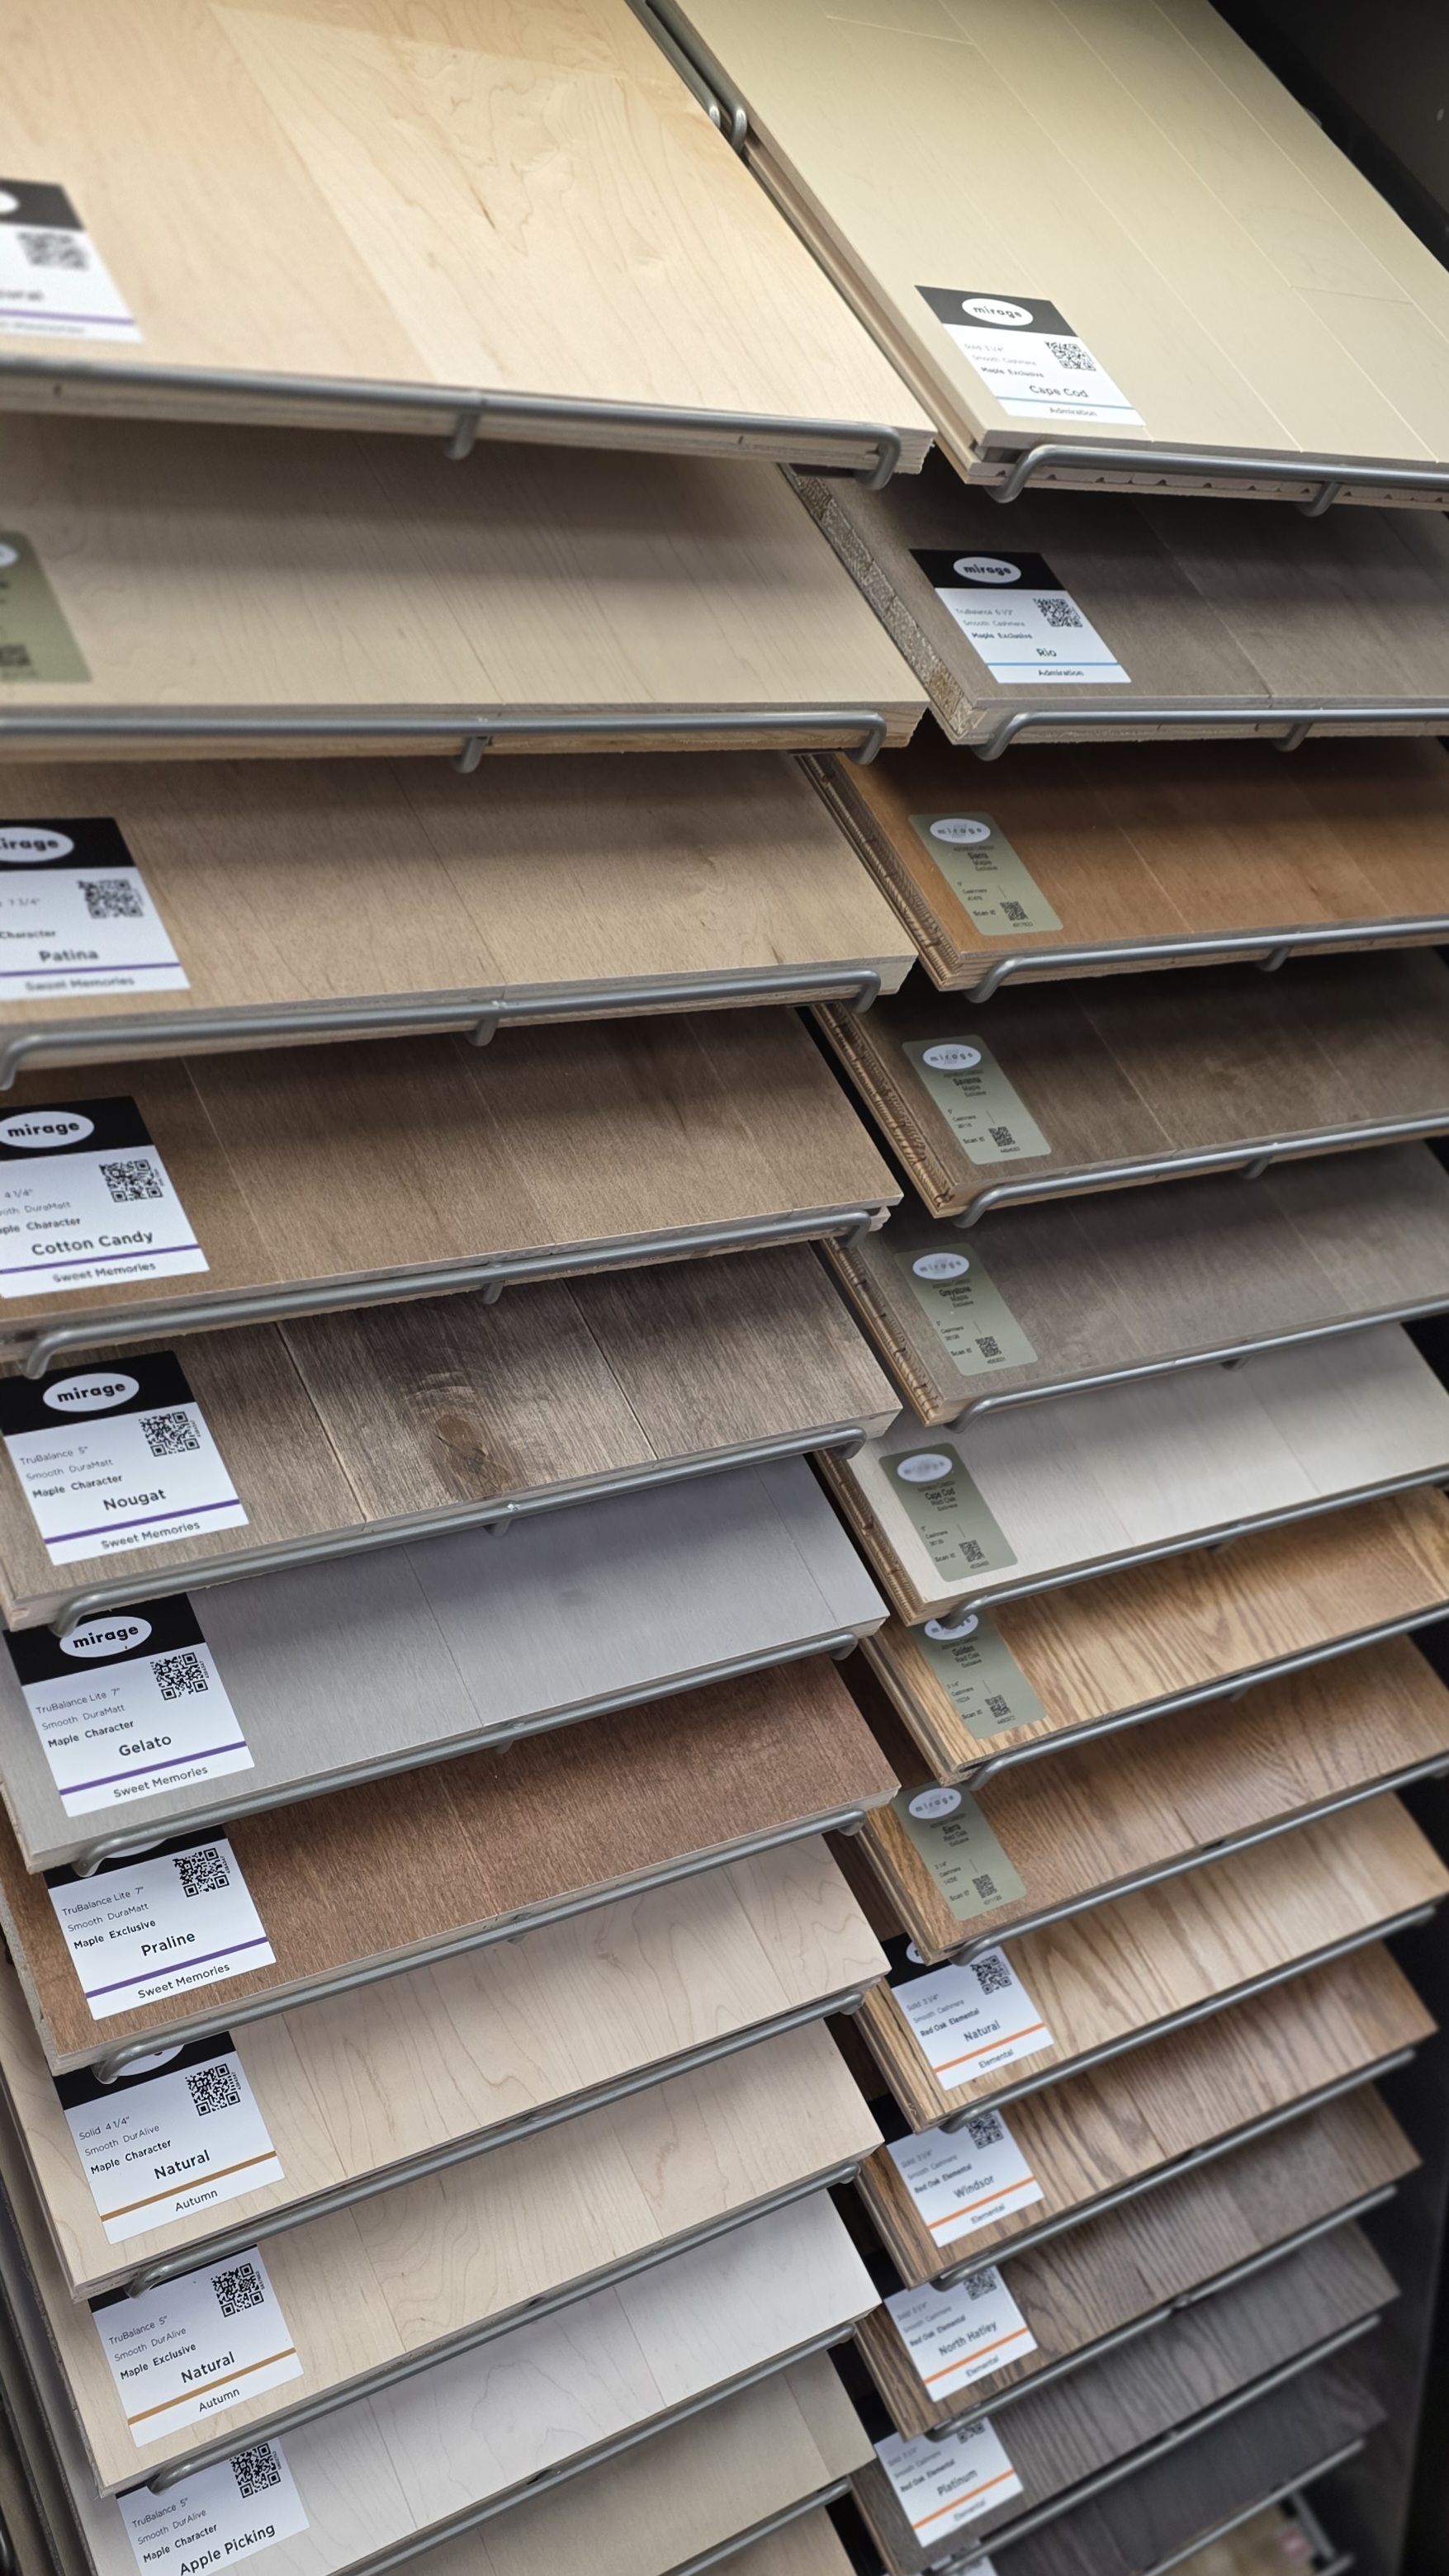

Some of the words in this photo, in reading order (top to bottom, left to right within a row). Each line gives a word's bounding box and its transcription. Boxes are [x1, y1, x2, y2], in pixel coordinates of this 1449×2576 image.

[973, 306, 1022, 318] mirage
[1007, 369, 1044, 378] Exclusive
[1030, 385, 1060, 398] Cape
[1063, 388, 1089, 398] Cod
[964, 565, 1011, 575] mirage
[1036, 648, 1057, 657] Rio
[0, 839, 59, 851] irage
[39, 950, 98, 962] Patina
[25, 981, 67, 990] Sweet
[71, 977, 135, 988] Memories
[7, 1123, 80, 1137] mirage
[26, 1217, 80, 1231] Character
[31, 1239, 93, 1255] Cotton
[98, 1231, 154, 1247] Candy
[53, 1270, 92, 1283] Sweet
[96, 1263, 155, 1277] Memories
[57, 1382, 125, 1402] mirage
[20, 1449, 73, 1466] TruBalance
[78, 1446, 88, 1454] 5"
[26, 1468, 64, 1482] Smooth
[69, 1458, 114, 1473] DuraMatt
[32, 1485, 65, 1499] Maple
[71, 1474, 122, 1491] Character
[102, 1489, 167, 1510] Nougat
[101, 1534, 139, 1550] Sweet
[141, 1521, 200, 1539] Memories
[73, 1626, 139, 1649] mirage
[36, 1697, 88, 1714] TruBalance
[90, 1692, 107, 1702] Lite
[111, 1688, 121, 1697] 7"
[41, 1716, 78, 1731] Smooth
[83, 1704, 125, 1721] DuraMatt
[48, 1733, 79, 1748] Maple
[84, 1720, 134, 1738] Character
[119, 1736, 172, 1756] Gelato
[114, 1781, 150, 1798] Sweet
[152, 1766, 208, 1788] Memories
[61, 1895, 112, 1917] TruBalance
[114, 1891, 130, 1902] Lite
[135, 1887, 144, 1895] 7"
[68, 1916, 103, 1932] Smooth
[107, 1903, 149, 1921] DuraMatt
[73, 1935, 104, 1950] Maple
[109, 1920, 156, 1940] Exclusive
[140, 1932, 196, 1956] Praline
[138, 1982, 173, 1999] Sweet
[175, 1963, 230, 1986] Memories
[920, 2028, 934, 2037] Red
[935, 2022, 947, 2031] Oak
[949, 2009, 980, 2025] Elemental
[964, 2020, 1001, 2042] Natural
[978, 2049, 1014, 2068] Elemental
[79, 2127, 101, 2141] Solid
[113, 2116, 130, 2129] 1/4"
[84, 2140, 118, 2157] Smooth
[123, 2124, 160, 2143] DurAlive
[91, 2158, 120, 2174] Maple
[125, 2139, 172, 2161] Character
[154, 2149, 211, 2179] Natural
[928, 2179, 940, 2187] Oak
[942, 2164, 973, 2181] Elemental
[954, 2176, 994, 2198] Windsor
[175, 2190, 217, 2212] Autumn
[971, 2204, 1006, 2224] Elemental
[108, 2321, 155, 2345] TruBalance
[159, 2316, 168, 2325] 5"
[939, 2337, 966, 2356] North
[967, 2322, 997, 2341] Hatley
[114, 2343, 147, 2362] Smooth
[151, 2328, 186, 2347] DurAlive
[121, 2362, 149, 2380] Maple
[153, 2342, 197, 2366] Exclusive
[181, 2351, 235, 2383] Natural
[198, 2388, 240, 2412] Autumn
[937, 2470, 978, 2495] Platinum
[131, 2503, 177, 2528] TruBalance
[180, 2498, 188, 2507] 5"
[137, 2526, 168, 2545] Smooth
[173, 2509, 206, 2530] DurAlive
[144, 2546, 170, 2563] Maple
[175, 2524, 217, 2548] Character
[180, 2549, 221, 2576] Apple
[224, 2525, 276, 2555] Picking
